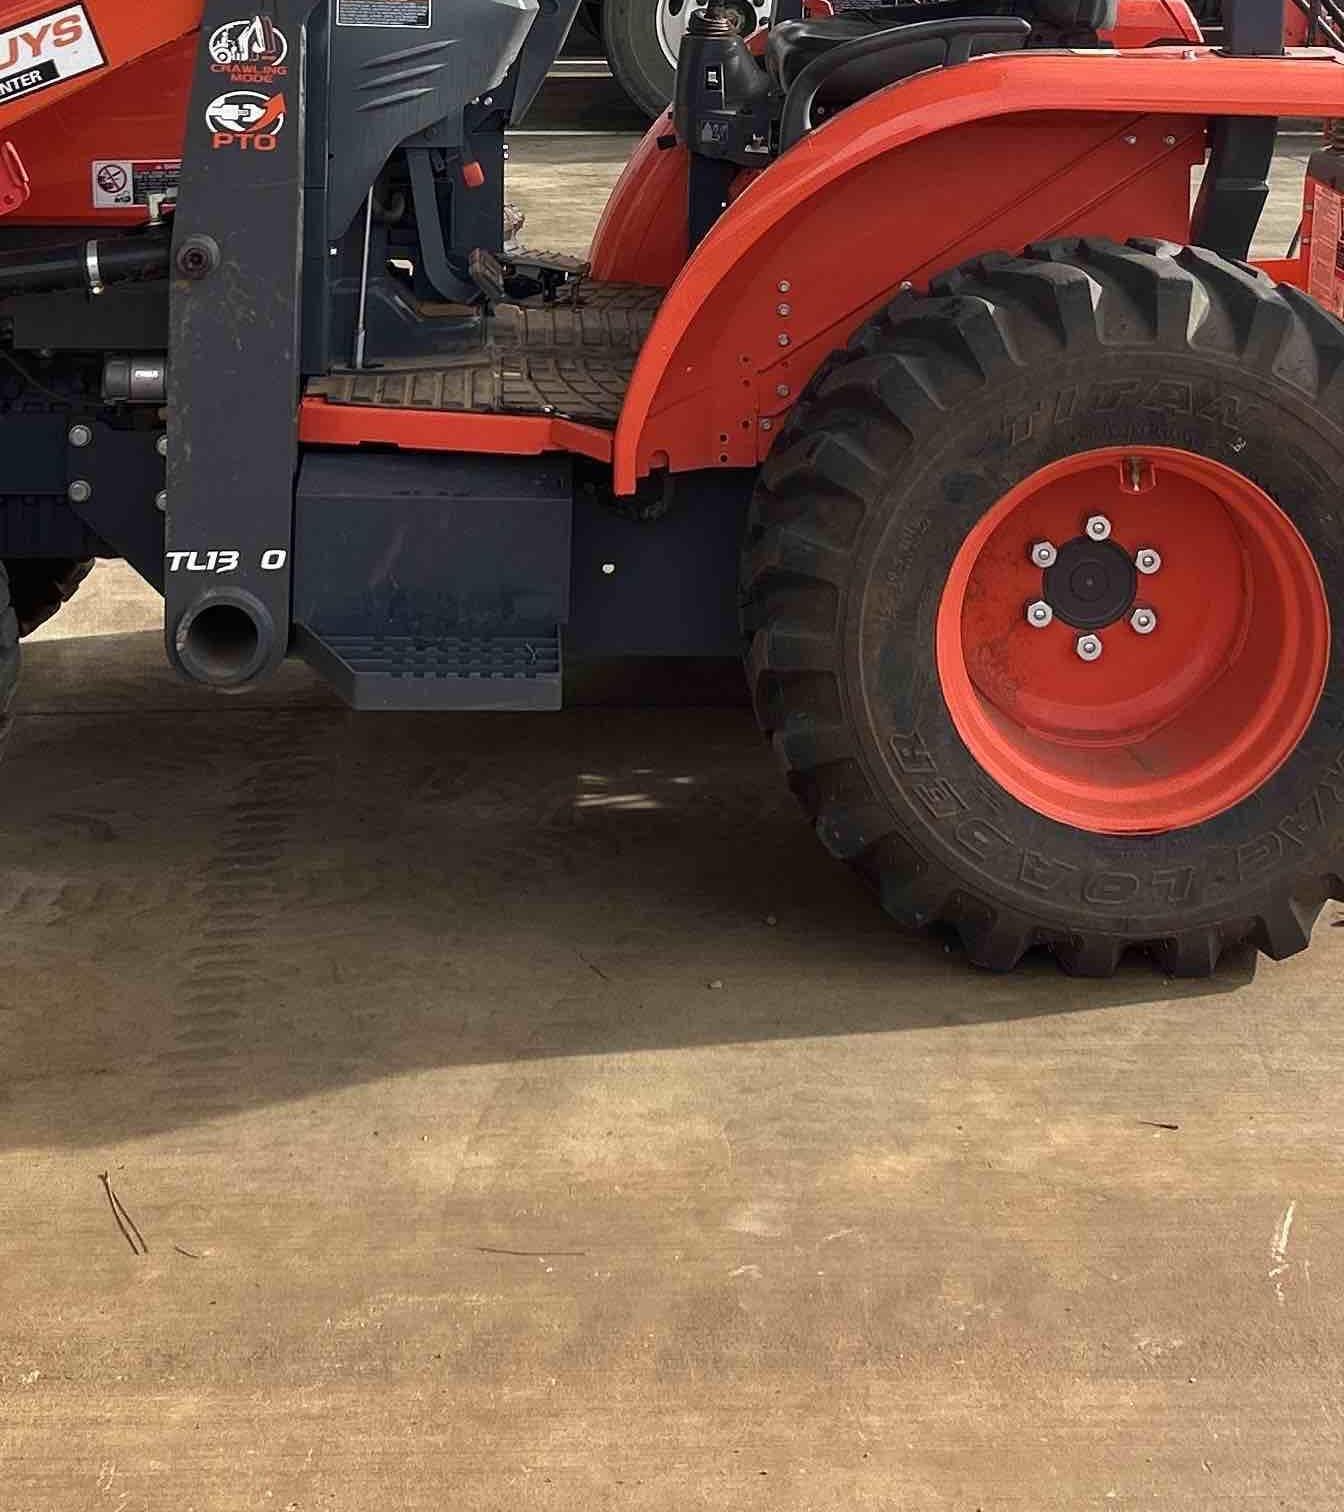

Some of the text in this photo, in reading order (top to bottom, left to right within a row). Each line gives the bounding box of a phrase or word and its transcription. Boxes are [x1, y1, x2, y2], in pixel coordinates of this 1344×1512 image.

[208, 63, 288, 76] CRAWLING
[230, 73, 273, 84] MODE
[211, 133, 278, 150] PTO
